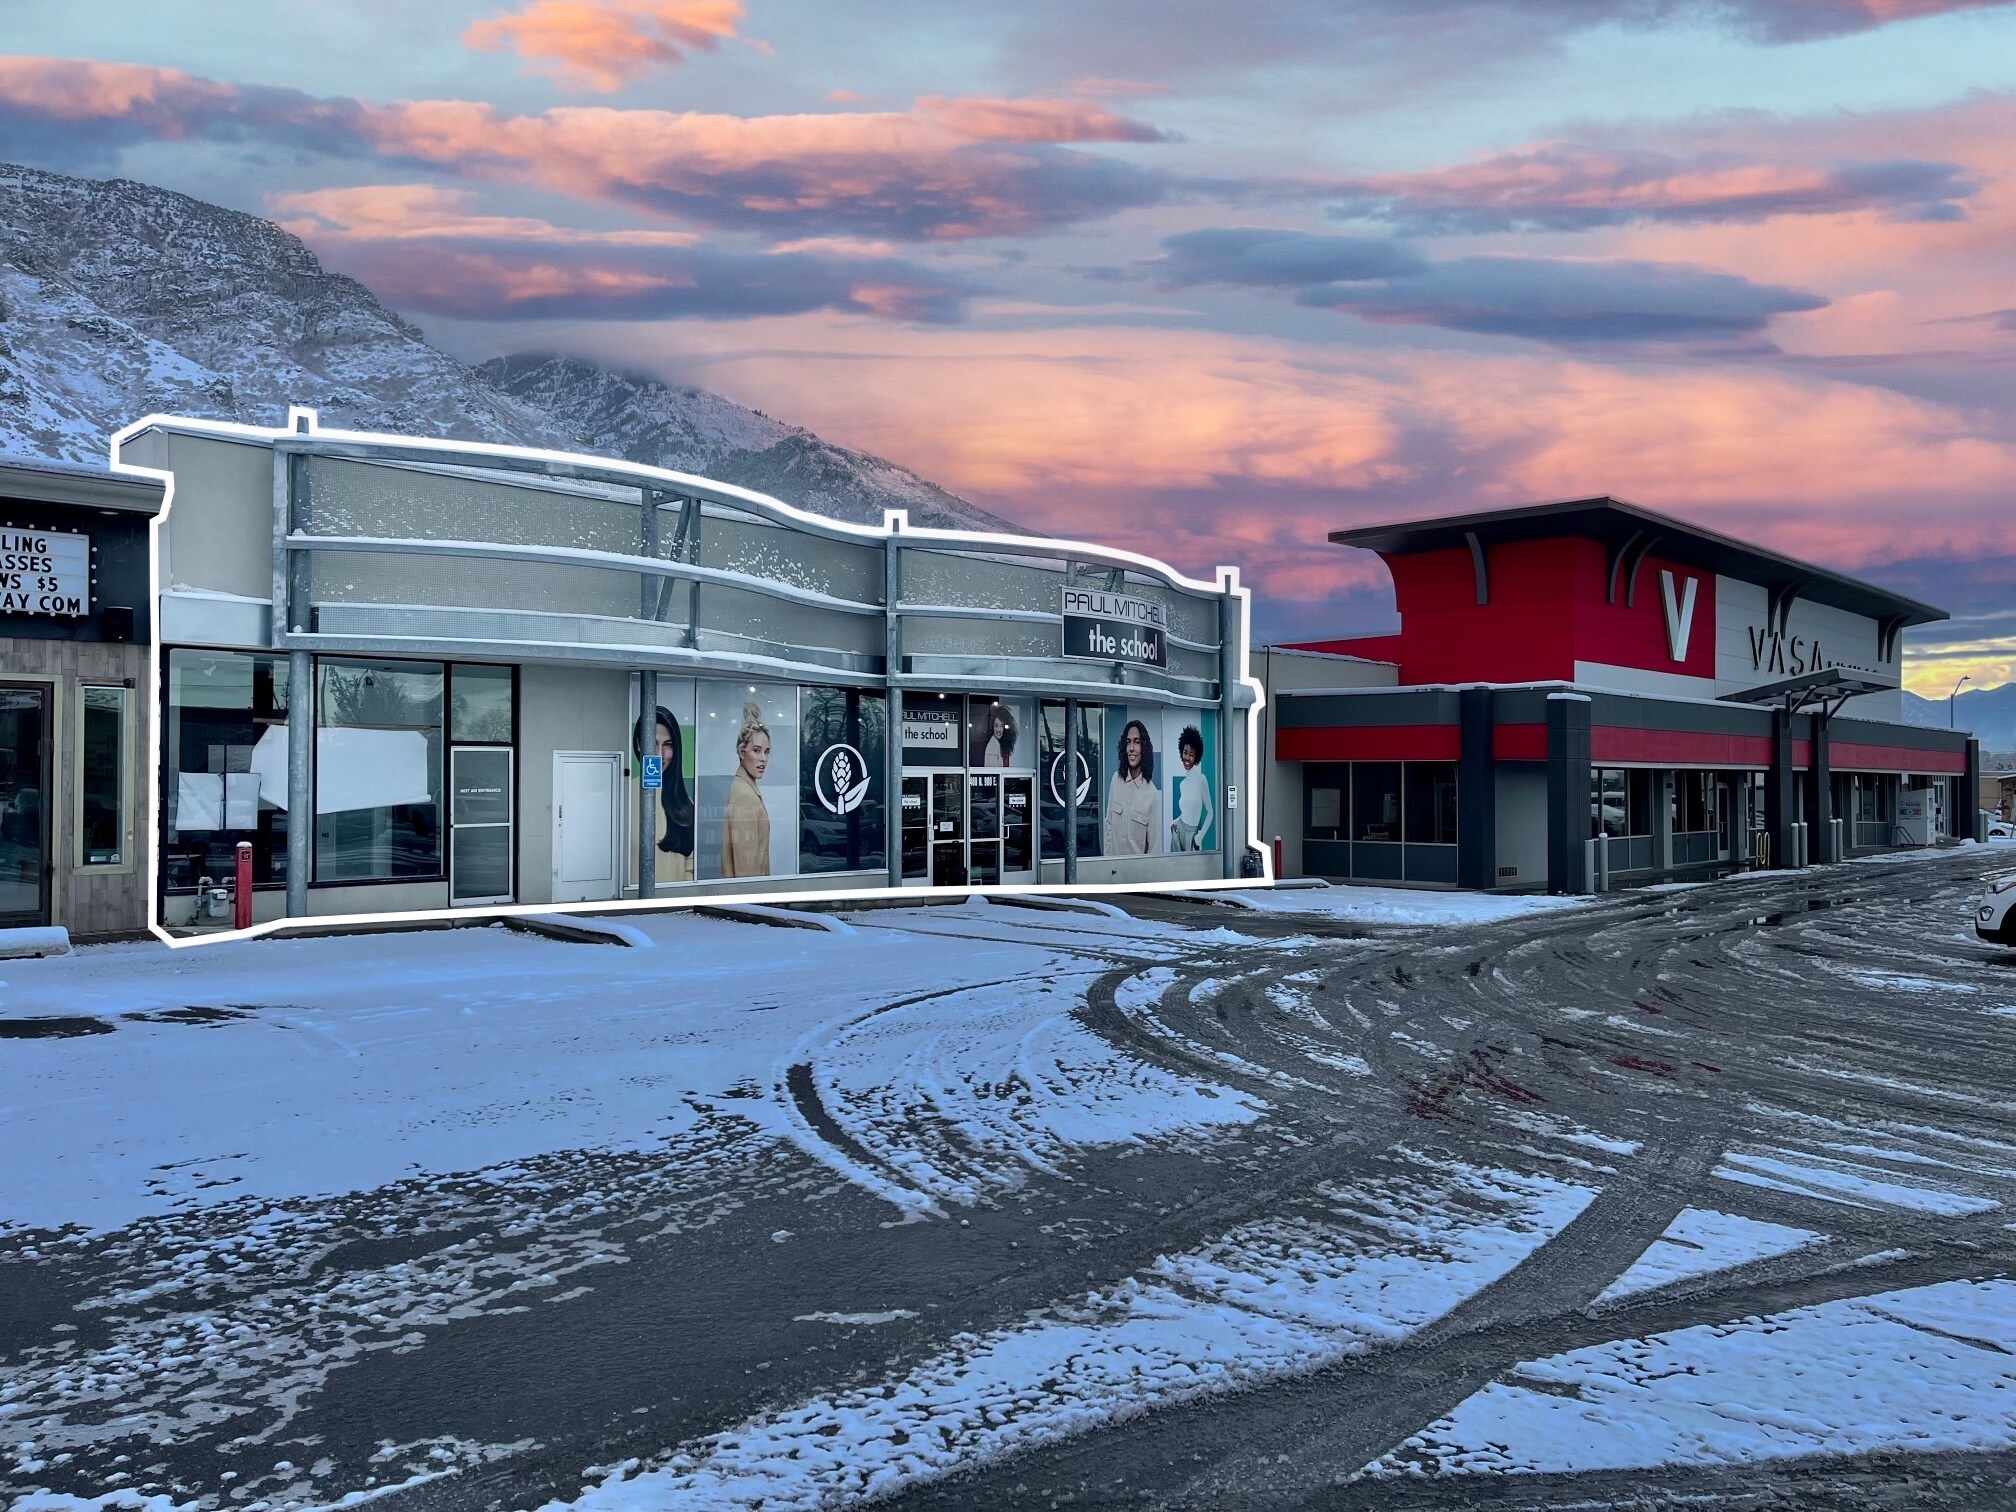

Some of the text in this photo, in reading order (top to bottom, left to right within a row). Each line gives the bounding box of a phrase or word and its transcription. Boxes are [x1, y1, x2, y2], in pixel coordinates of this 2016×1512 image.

[0, 553, 52, 573] SSES
[37, 576, 59, 592] $5
[0, 591, 80, 613] AY COM
[1065, 592, 1166, 626] PAUL MITCHELL
[1659, 569, 1699, 662] V
[1088, 623, 1158, 661] the school
[1748, 625, 1823, 676] VASA
[917, 711, 959, 722] MITCHELL
[904, 726, 948, 740] the school
